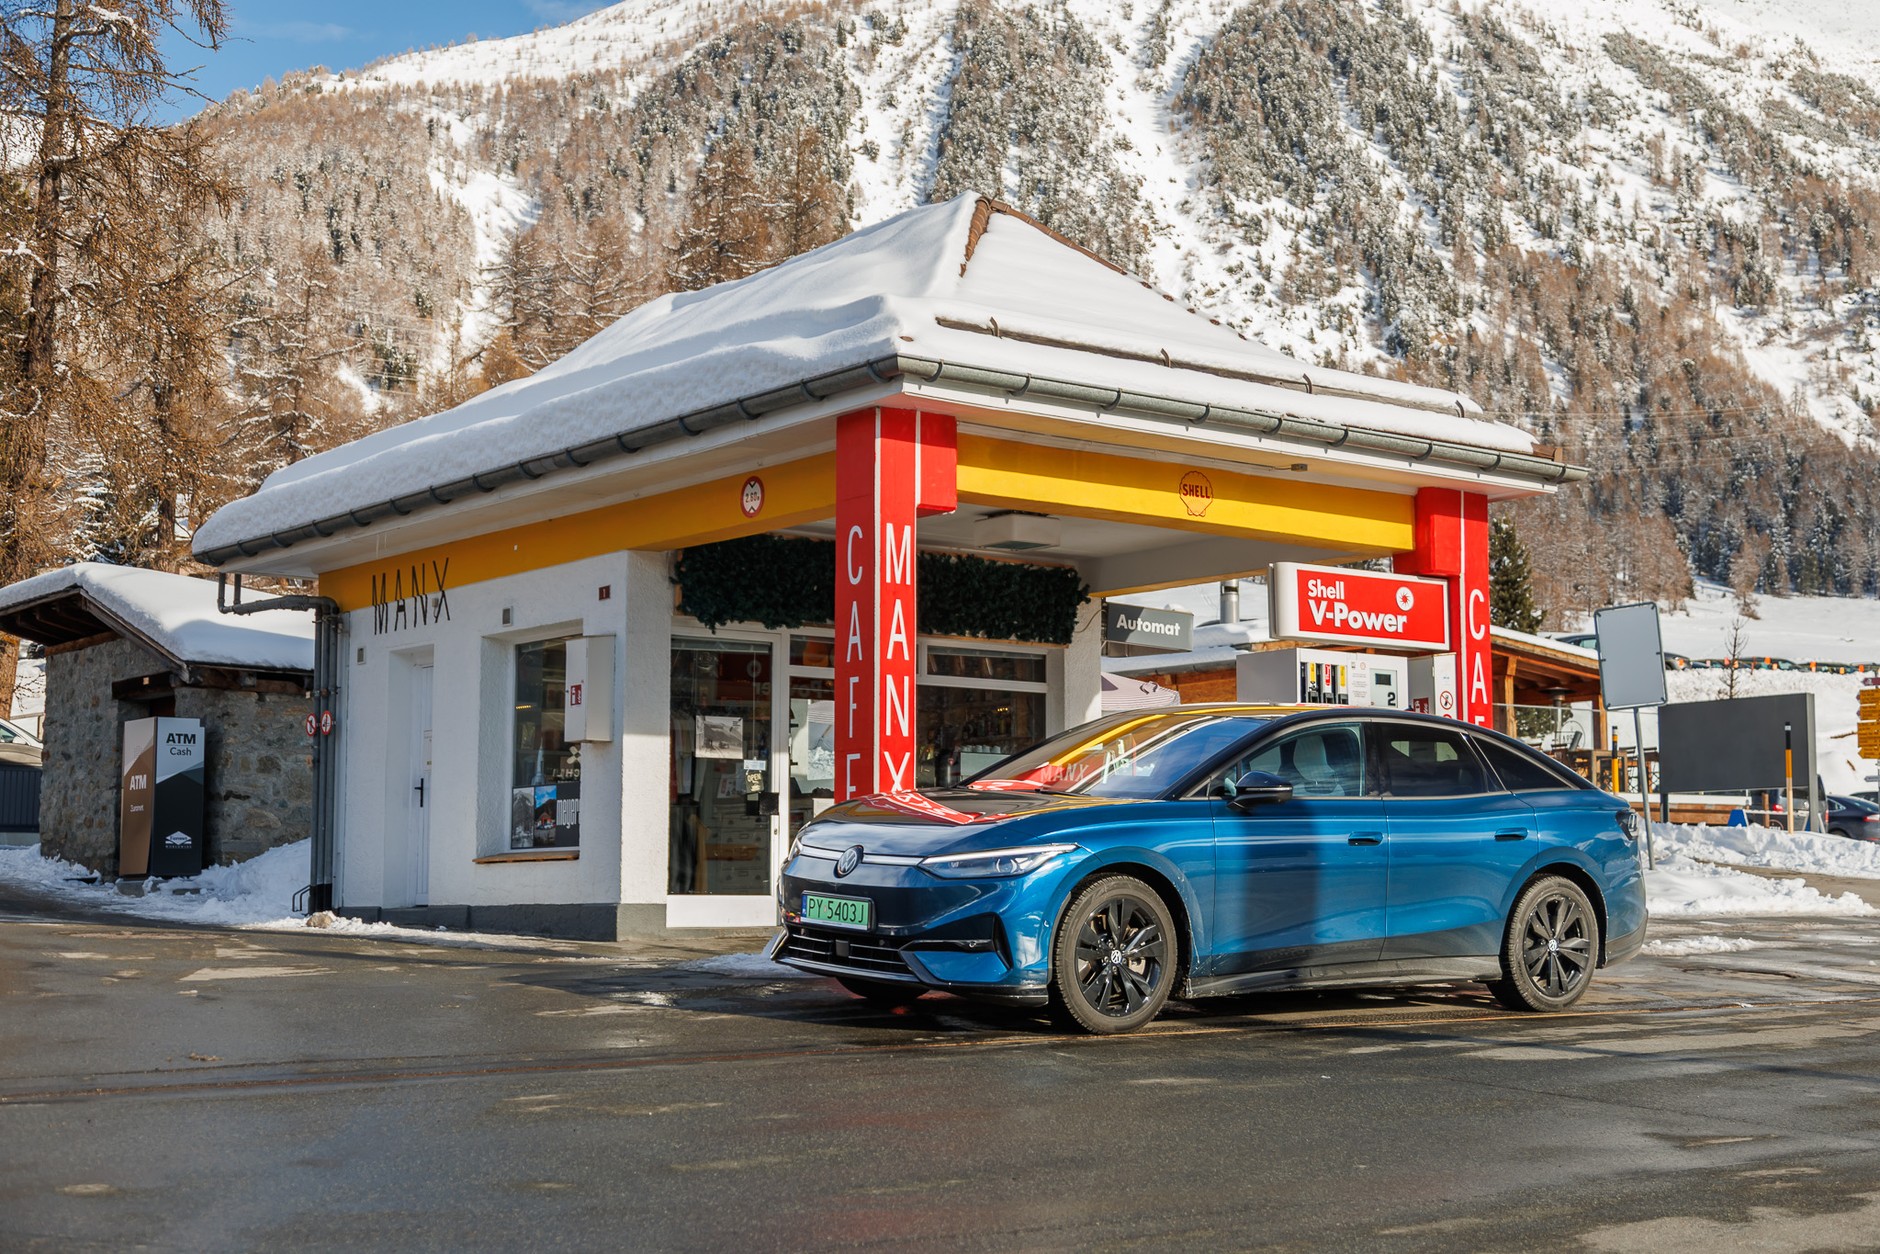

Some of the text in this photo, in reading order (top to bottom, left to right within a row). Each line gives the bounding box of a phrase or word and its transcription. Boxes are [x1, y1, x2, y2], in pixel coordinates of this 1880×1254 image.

[1182, 483, 1211, 499] SHELL
[372, 557, 451, 635] MANX
[1307, 579, 1345, 600] Shell
[1116, 614, 1181, 636] Automat
[1308, 599, 1408, 633] V-Power
[884, 523, 912, 791] MANX
[1469, 589, 1488, 726] CA
[1387, 691, 1396, 707] 2
[166, 733, 196, 745] ATM
[169, 747, 192, 756] Cash
[129, 774, 147, 791] ATM
[808, 898, 864, 923] PY 5403J
